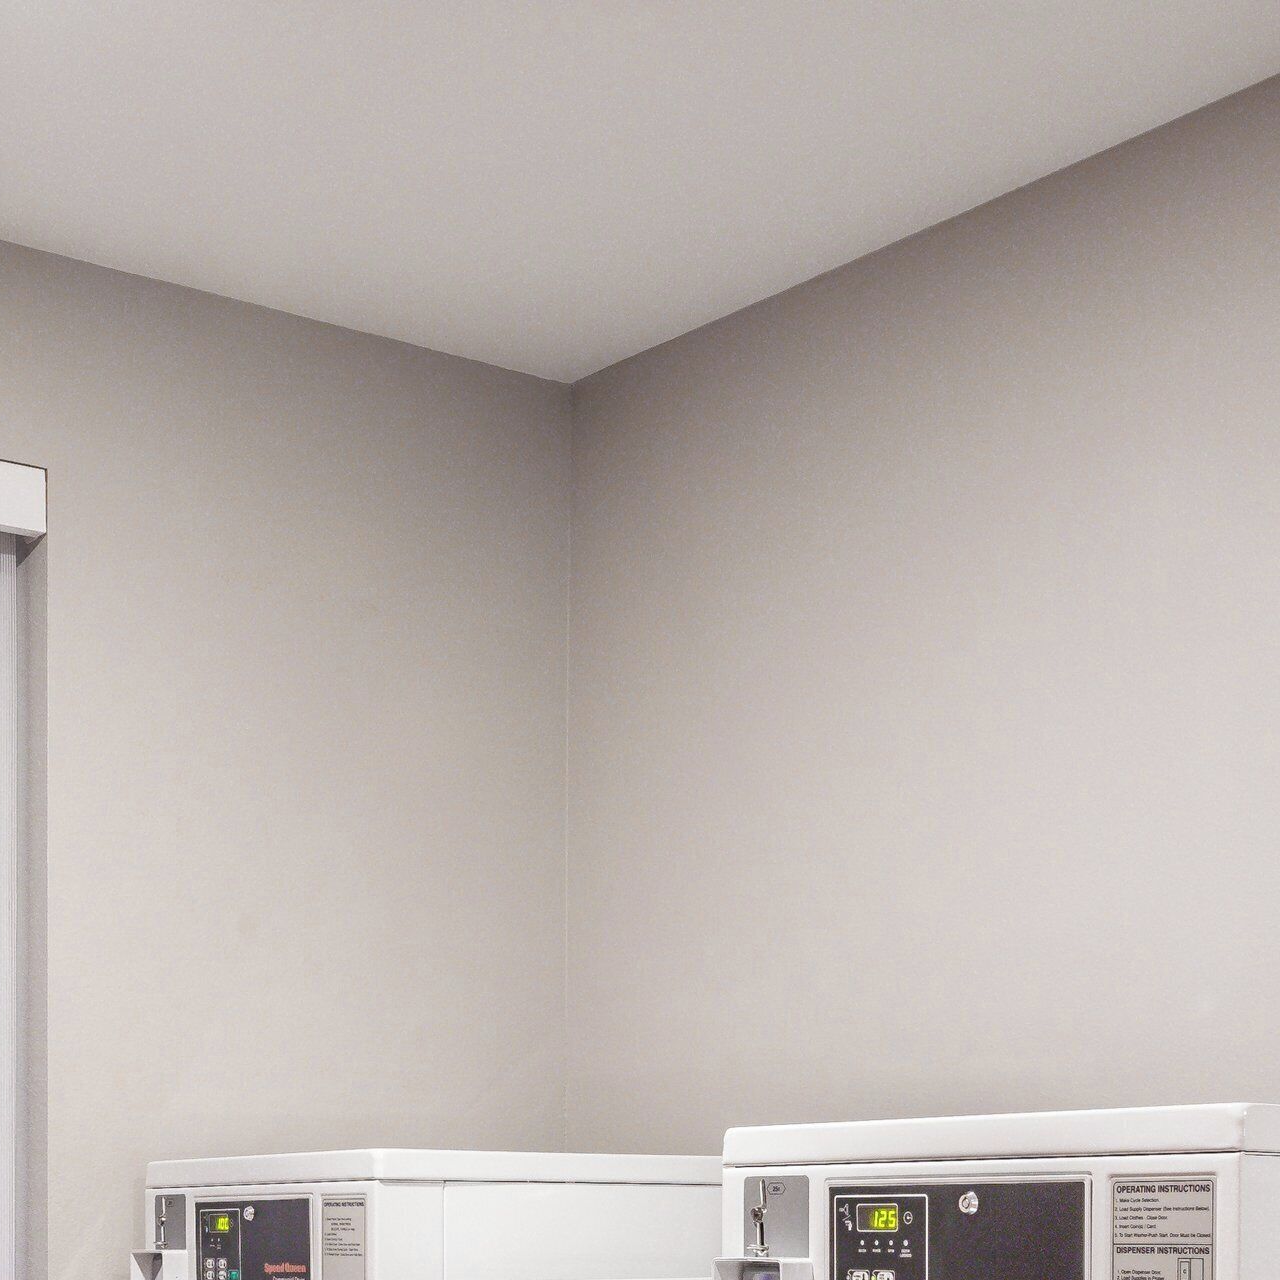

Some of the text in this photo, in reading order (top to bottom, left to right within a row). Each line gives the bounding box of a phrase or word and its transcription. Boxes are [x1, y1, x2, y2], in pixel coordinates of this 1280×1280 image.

[1117, 1184, 1210, 1193] OPERATING INSTRUCTIONS
[873, 1209, 896, 1228] 125
[264, 1262, 306, 1274] Speed Queen
